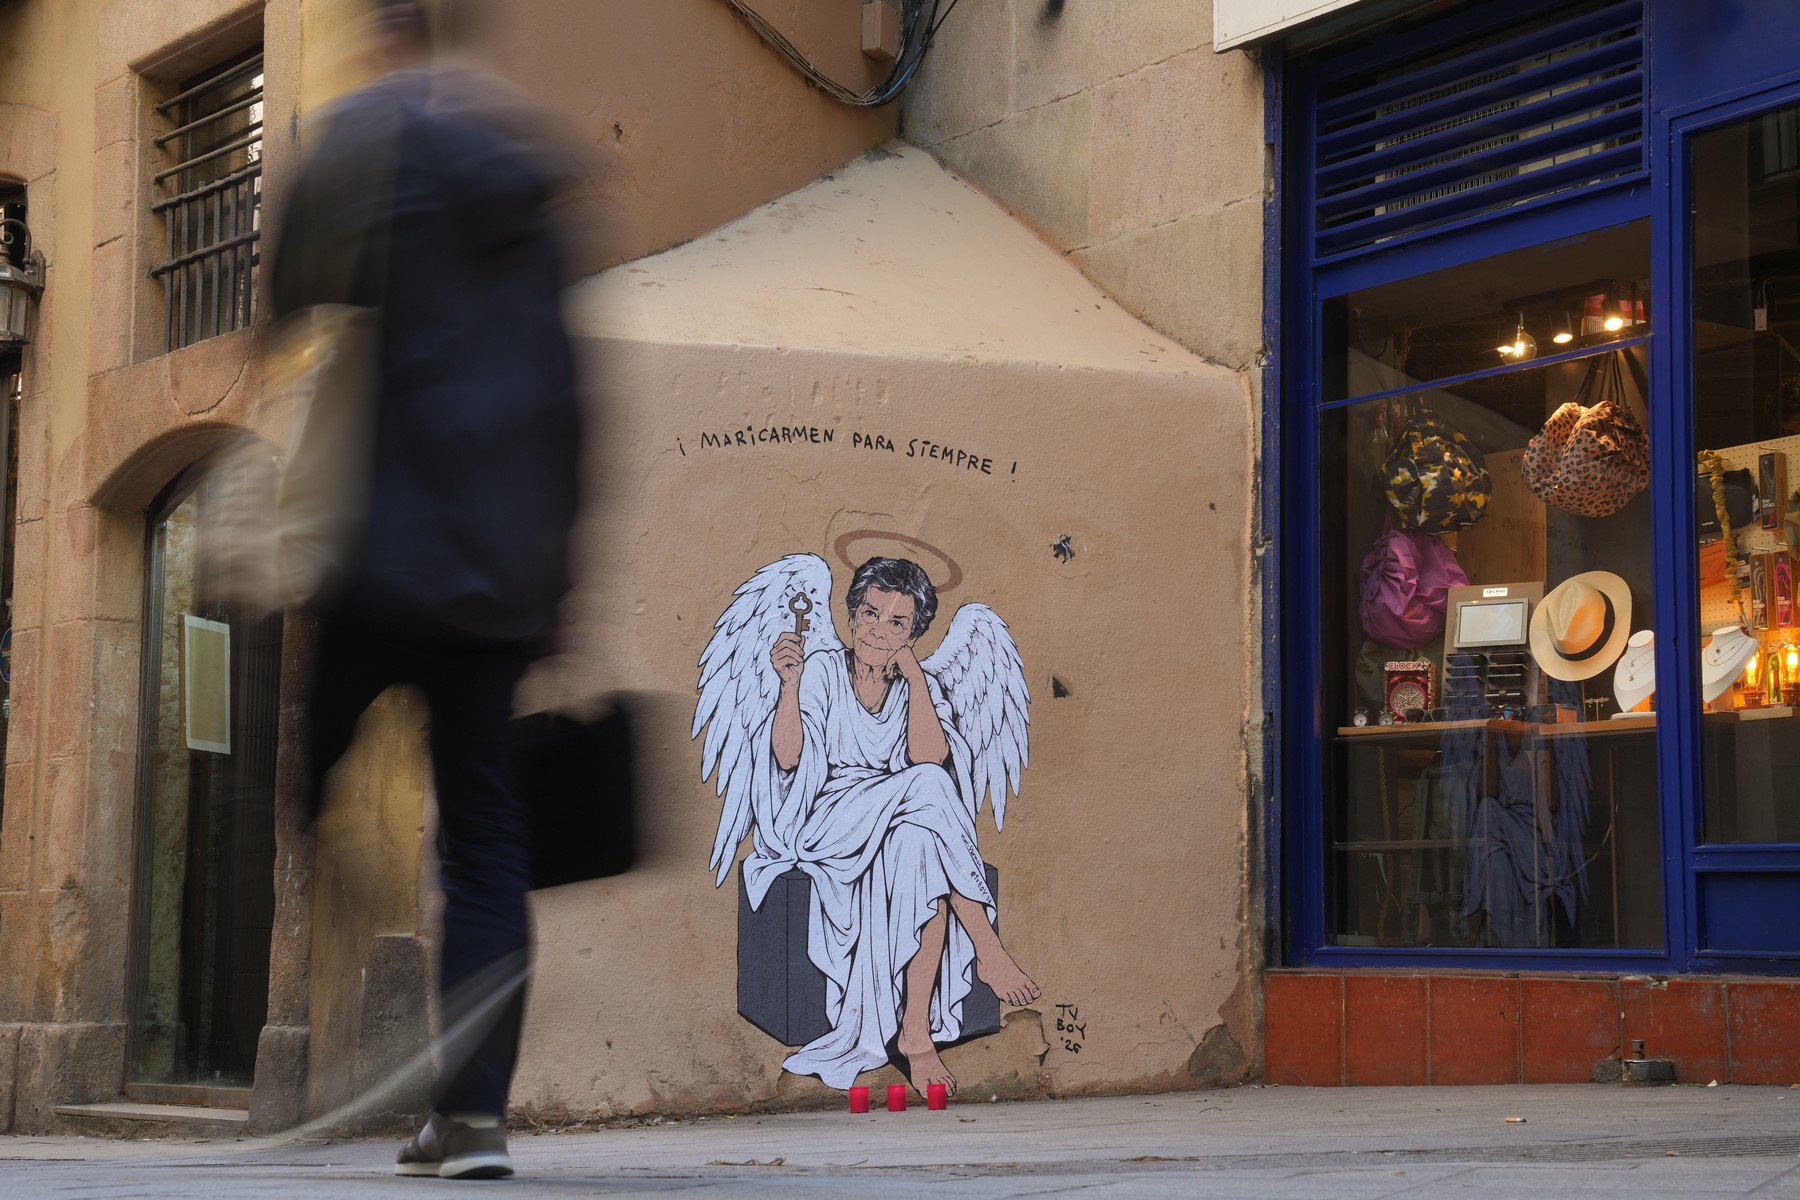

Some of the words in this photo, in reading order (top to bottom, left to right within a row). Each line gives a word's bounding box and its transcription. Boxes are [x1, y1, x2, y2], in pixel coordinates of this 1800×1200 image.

[852, 431, 895, 453] PARA
[1388, 662, 1419, 670] CLOCK
[1055, 1003, 1079, 1021] TV
[1056, 1017, 1087, 1041] BOY
